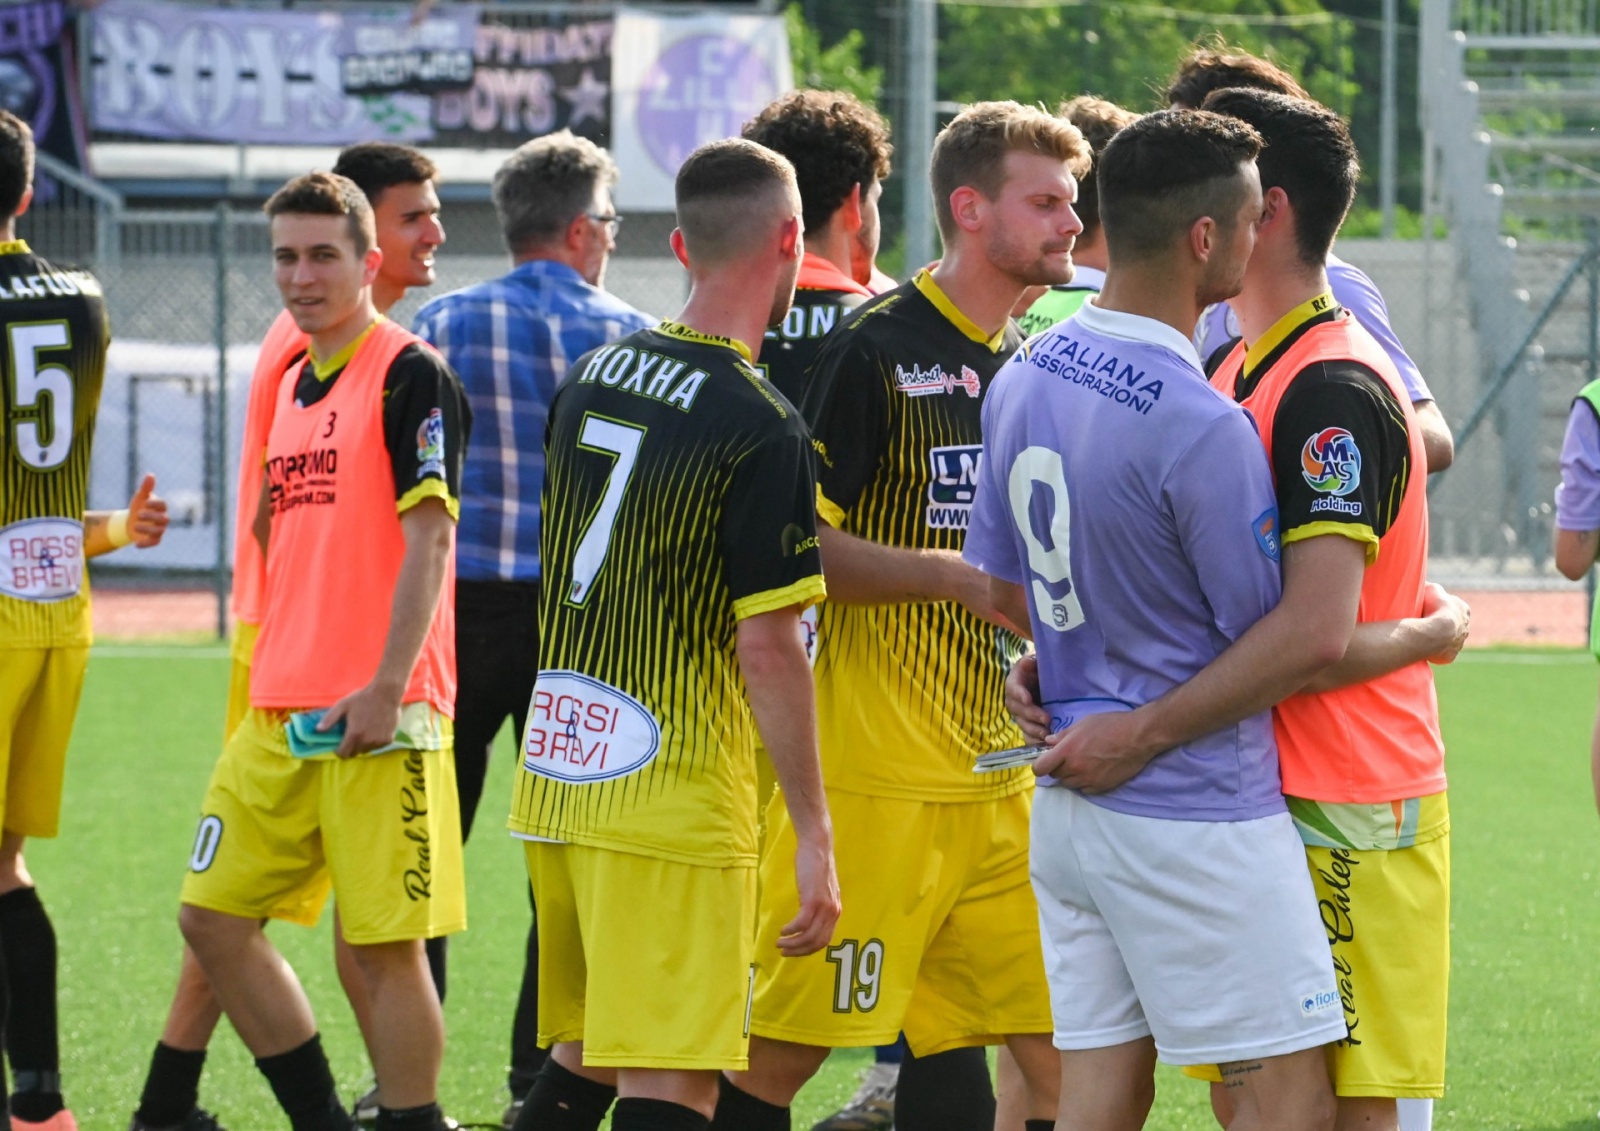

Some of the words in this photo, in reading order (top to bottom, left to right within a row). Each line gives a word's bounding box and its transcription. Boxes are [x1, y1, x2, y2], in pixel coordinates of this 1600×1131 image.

[6, 319, 74, 472] 5
[578, 344, 711, 413] HOXHA
[1029, 352, 1154, 415] ASSICURAZIONI
[1040, 332, 1164, 401] ITALIANA
[323, 411, 337, 438] 3
[563, 411, 648, 609] 7
[1008, 446, 1085, 631] 9
[1311, 498, 1362, 515] Holding
[526, 727, 609, 770] BREVI
[190, 814, 224, 873] 0
[403, 826, 432, 902] Real
[825, 937, 885, 1014] 19
